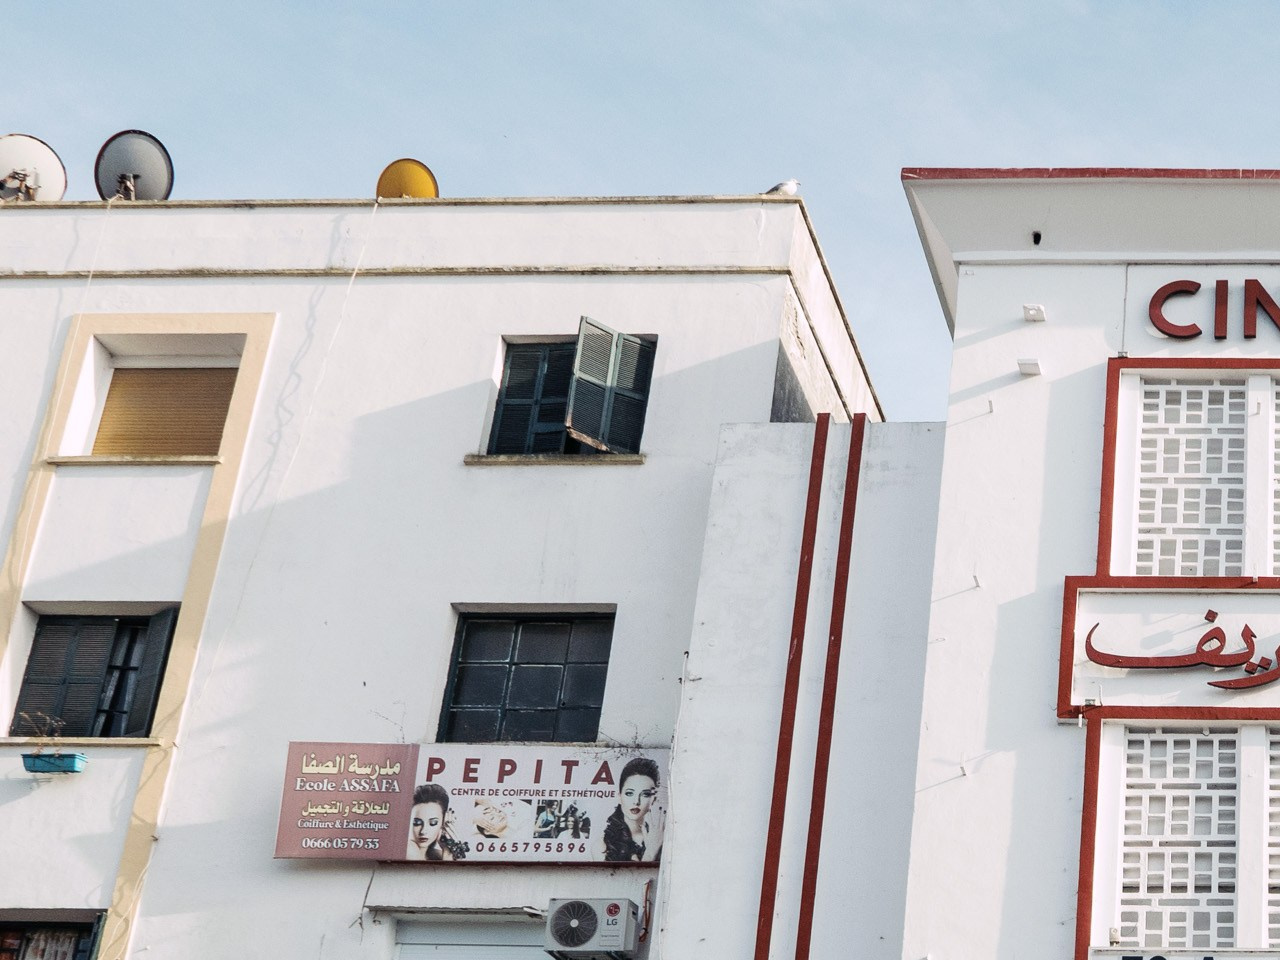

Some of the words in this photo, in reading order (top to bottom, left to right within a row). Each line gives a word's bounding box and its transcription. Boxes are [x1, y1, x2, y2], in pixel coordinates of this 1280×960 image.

[301, 752, 346, 775] الصفا
[348, 753, 401, 780] مدرسة
[426, 757, 616, 785] PEPITA
[295, 777, 336, 791] Ecole
[339, 779, 401, 793] ASSAFA
[450, 787, 486, 797] CENTRE
[488, 788, 500, 797] DE
[502, 788, 546, 798] COIFFURE
[548, 789, 560, 797] ET
[561, 787, 616, 799] ESTHÉTIQUE
[298, 818, 334, 829] Coiffure
[335, 820, 342, 829] &
[342, 820, 389, 832] Esthétique
[302, 838, 331, 849] 0666
[332, 839, 348, 849] 05
[350, 839, 363, 849] 79
[475, 842, 586, 853] 0665795896
[606, 918, 618, 926] LG
